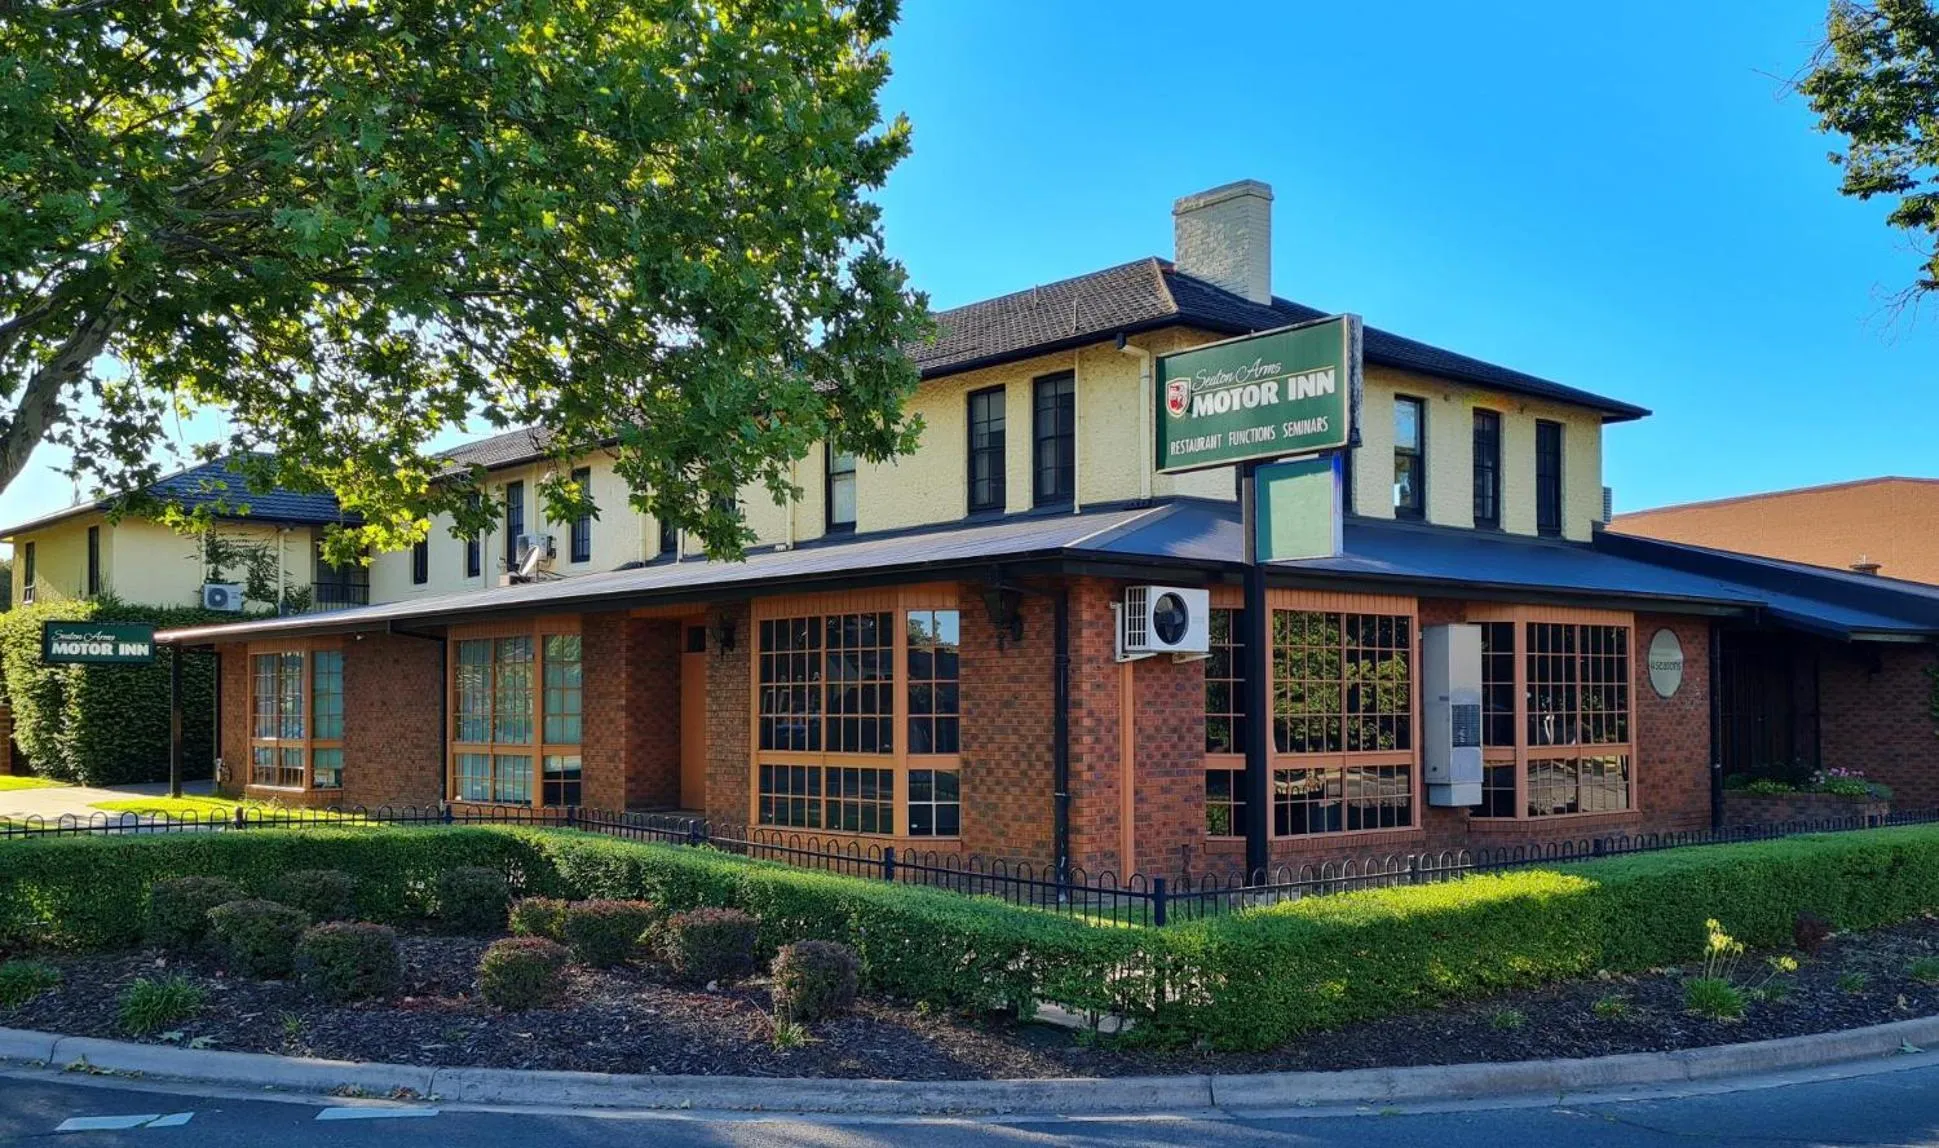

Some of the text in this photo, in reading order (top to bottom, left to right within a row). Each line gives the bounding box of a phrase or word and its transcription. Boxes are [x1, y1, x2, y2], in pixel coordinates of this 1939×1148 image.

[1236, 358, 1282, 383] Arms
[1192, 370, 1335, 418] MOTOR INN
[1170, 416, 1329, 455] RESTAURANT FUNCTIONS SEMINARS
[84, 630, 116, 641] Arms
[51, 643, 150, 656] MOTOR INN
